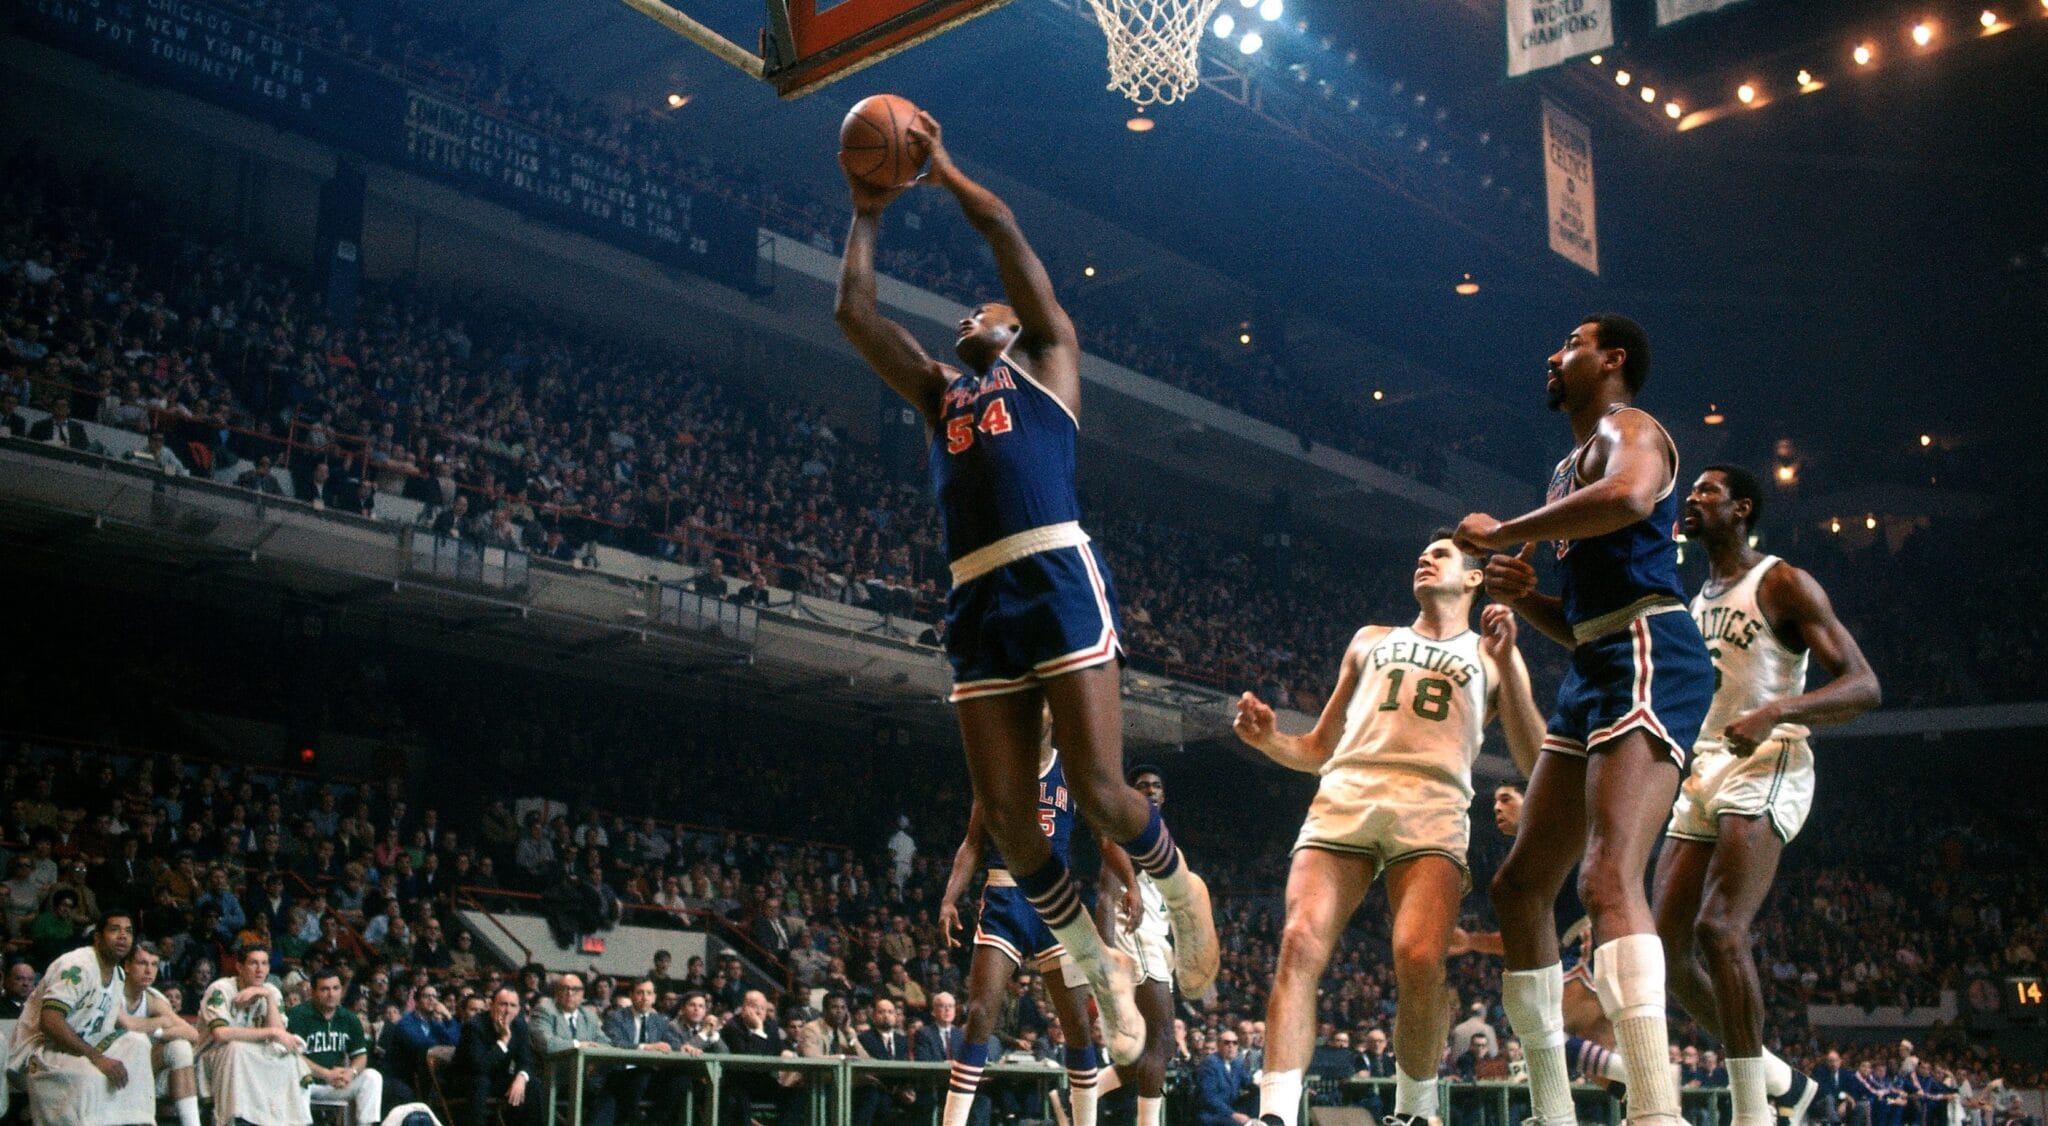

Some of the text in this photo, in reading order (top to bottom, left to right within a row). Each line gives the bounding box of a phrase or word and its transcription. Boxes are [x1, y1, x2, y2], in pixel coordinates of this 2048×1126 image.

[94, 16, 134, 45] POT
[150, 37, 239, 81] TOURNEY
[145, 14, 189, 42] NEW
[204, 34, 256, 67] YORK
[1521, 10, 1598, 50] CHAMPIONS
[470, 135, 540, 173] CELTICS
[947, 397, 1012, 454] 54
[1696, 608, 1762, 650] LTICS
[1373, 642, 1479, 688] CELTICS
[1378, 668, 1453, 722] 18
[2017, 981, 2042, 1004] 14
